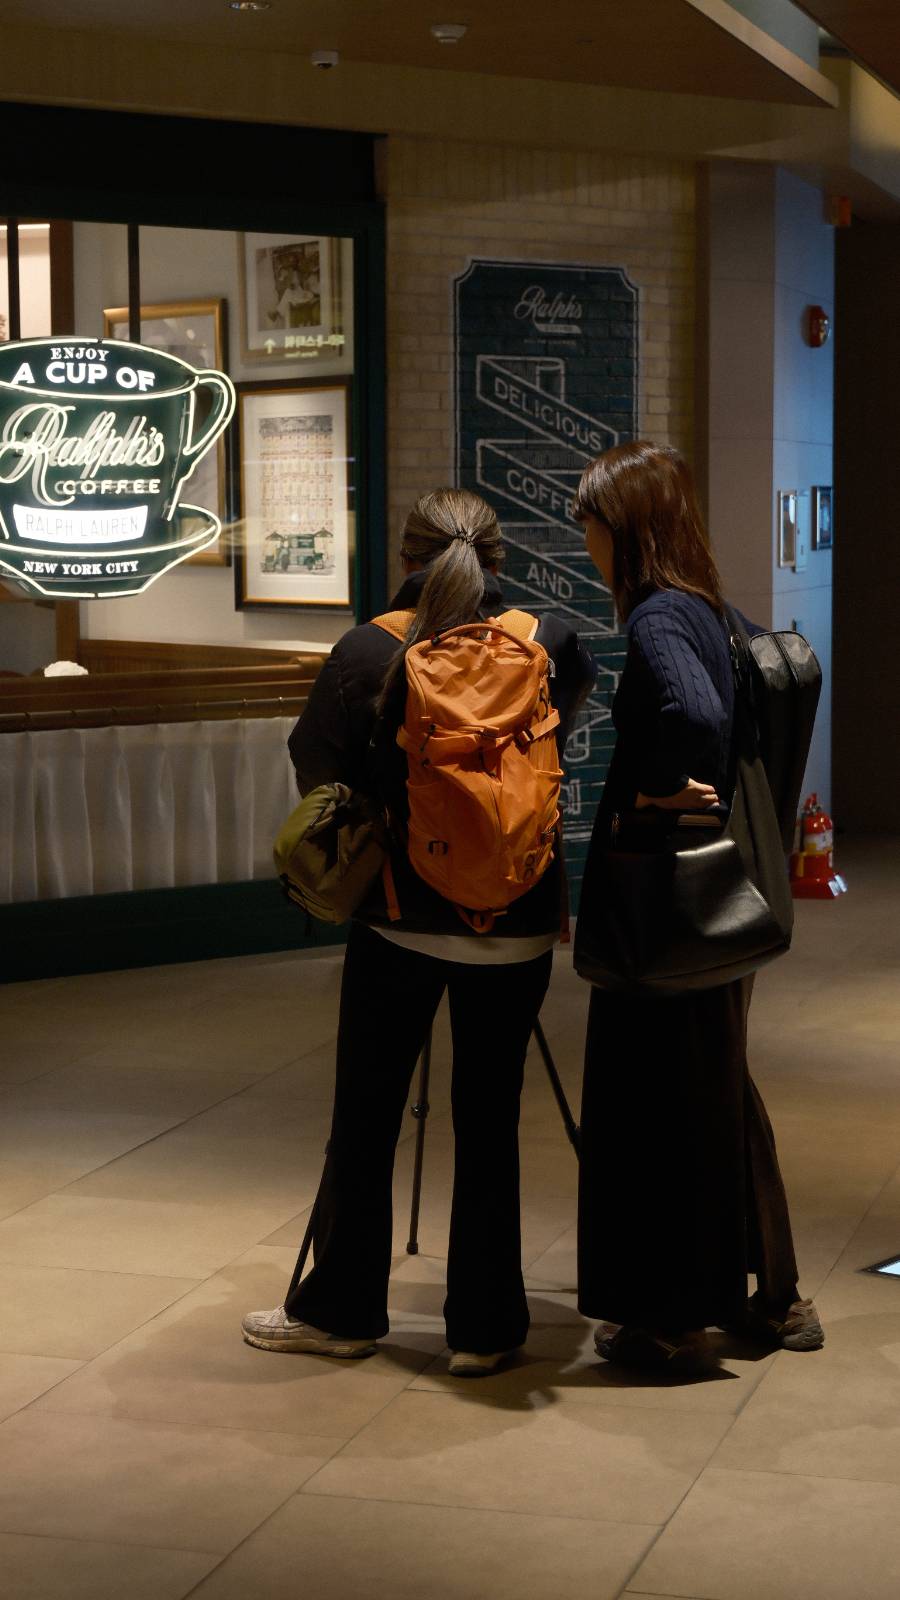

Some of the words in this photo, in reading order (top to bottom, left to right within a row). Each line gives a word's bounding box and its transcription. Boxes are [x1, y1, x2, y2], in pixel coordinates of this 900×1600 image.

[50, 347, 110, 362] ENJOY
[10, 362, 36, 386] A
[45, 362, 108, 384] CUP
[115, 368, 156, 392] OF
[494, 377, 602, 451] DELICIOUS
[0, 403, 165, 506] Ralph's
[57, 479, 161, 496] COFFEE
[507, 470, 579, 523] COFFE
[25, 513, 73, 536] RALPH
[80, 515, 138, 536] LAUREN
[23, 561, 56, 574] NEW
[61, 563, 102, 575] YORK
[105, 561, 139, 574] CITY
[527, 562, 573, 599] AND
